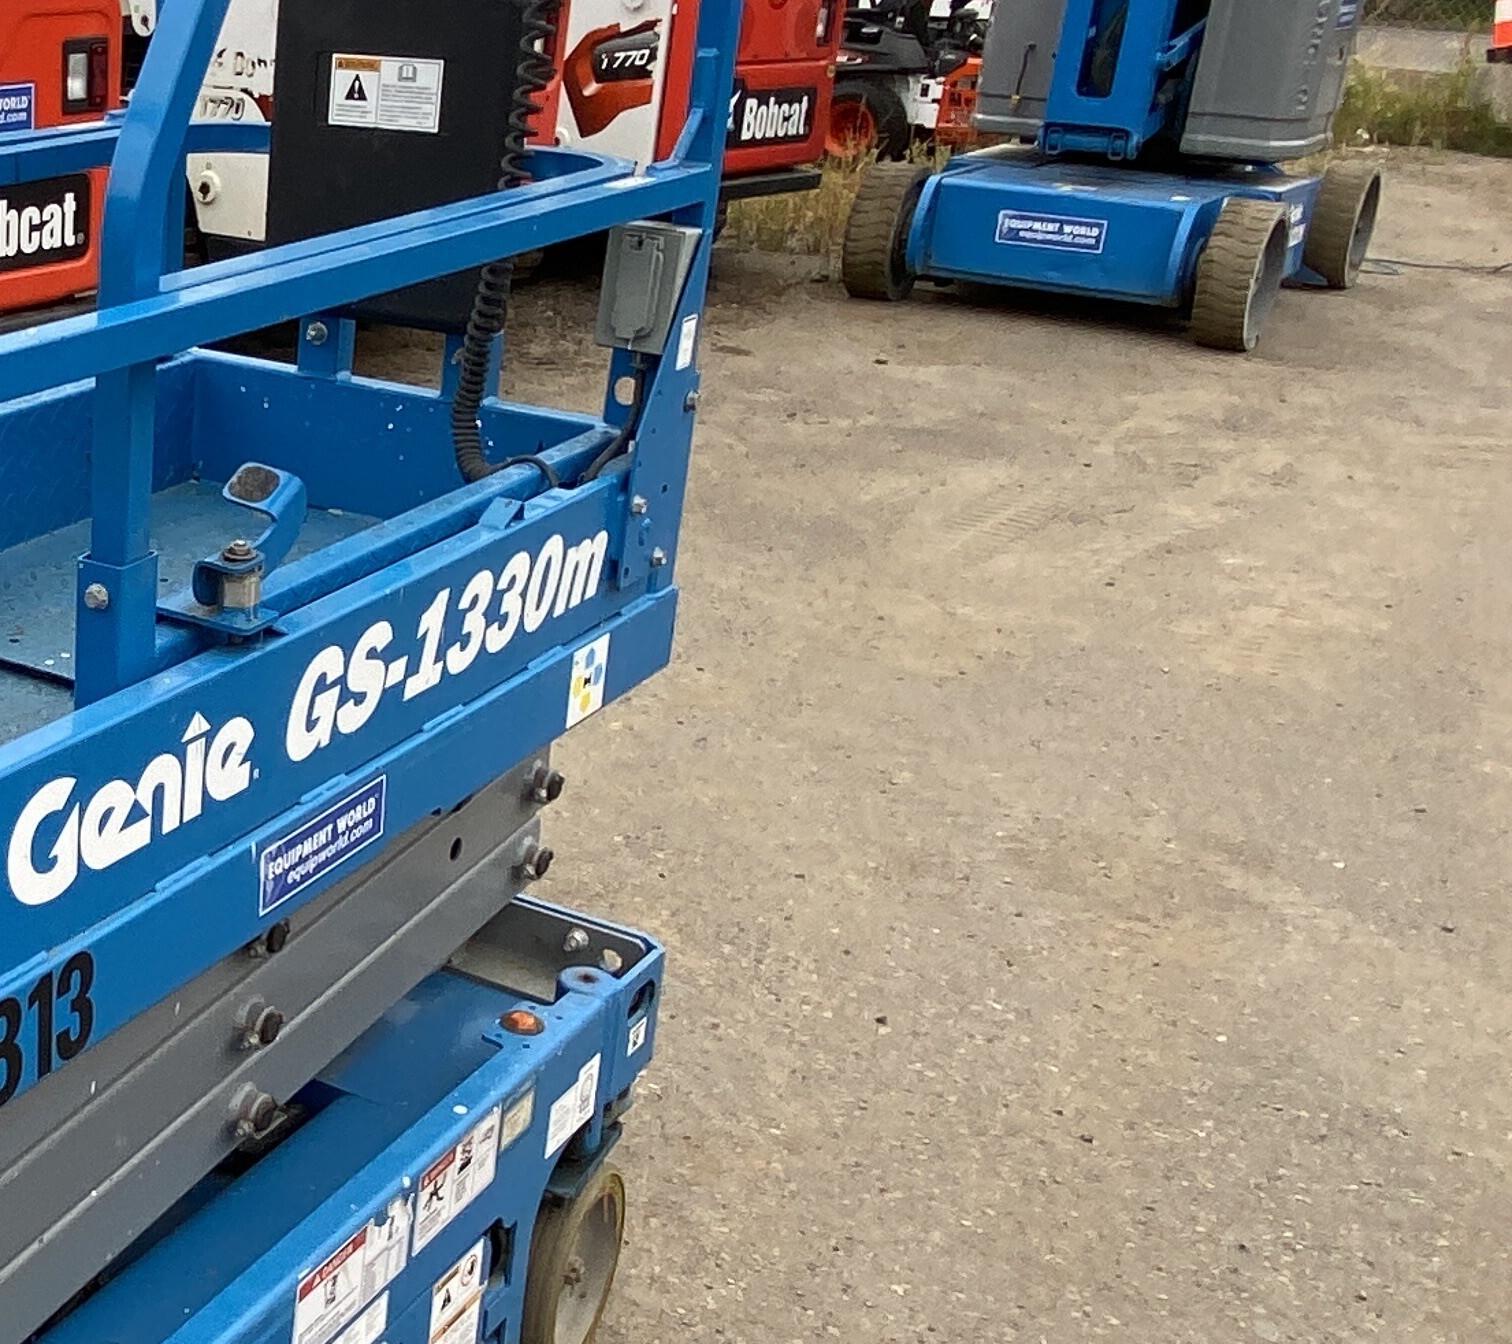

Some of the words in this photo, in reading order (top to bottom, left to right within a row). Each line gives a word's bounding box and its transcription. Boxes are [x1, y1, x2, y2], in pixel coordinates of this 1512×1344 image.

[741, 96, 808, 141] Bobcat
[7, 711, 255, 906] Genie
[285, 530, 609, 762] GS-1330m
[268, 823, 334, 880] EQUIPMENT
[336, 796, 376, 834] WORLD
[286, 817, 374, 885] equipworld.com
